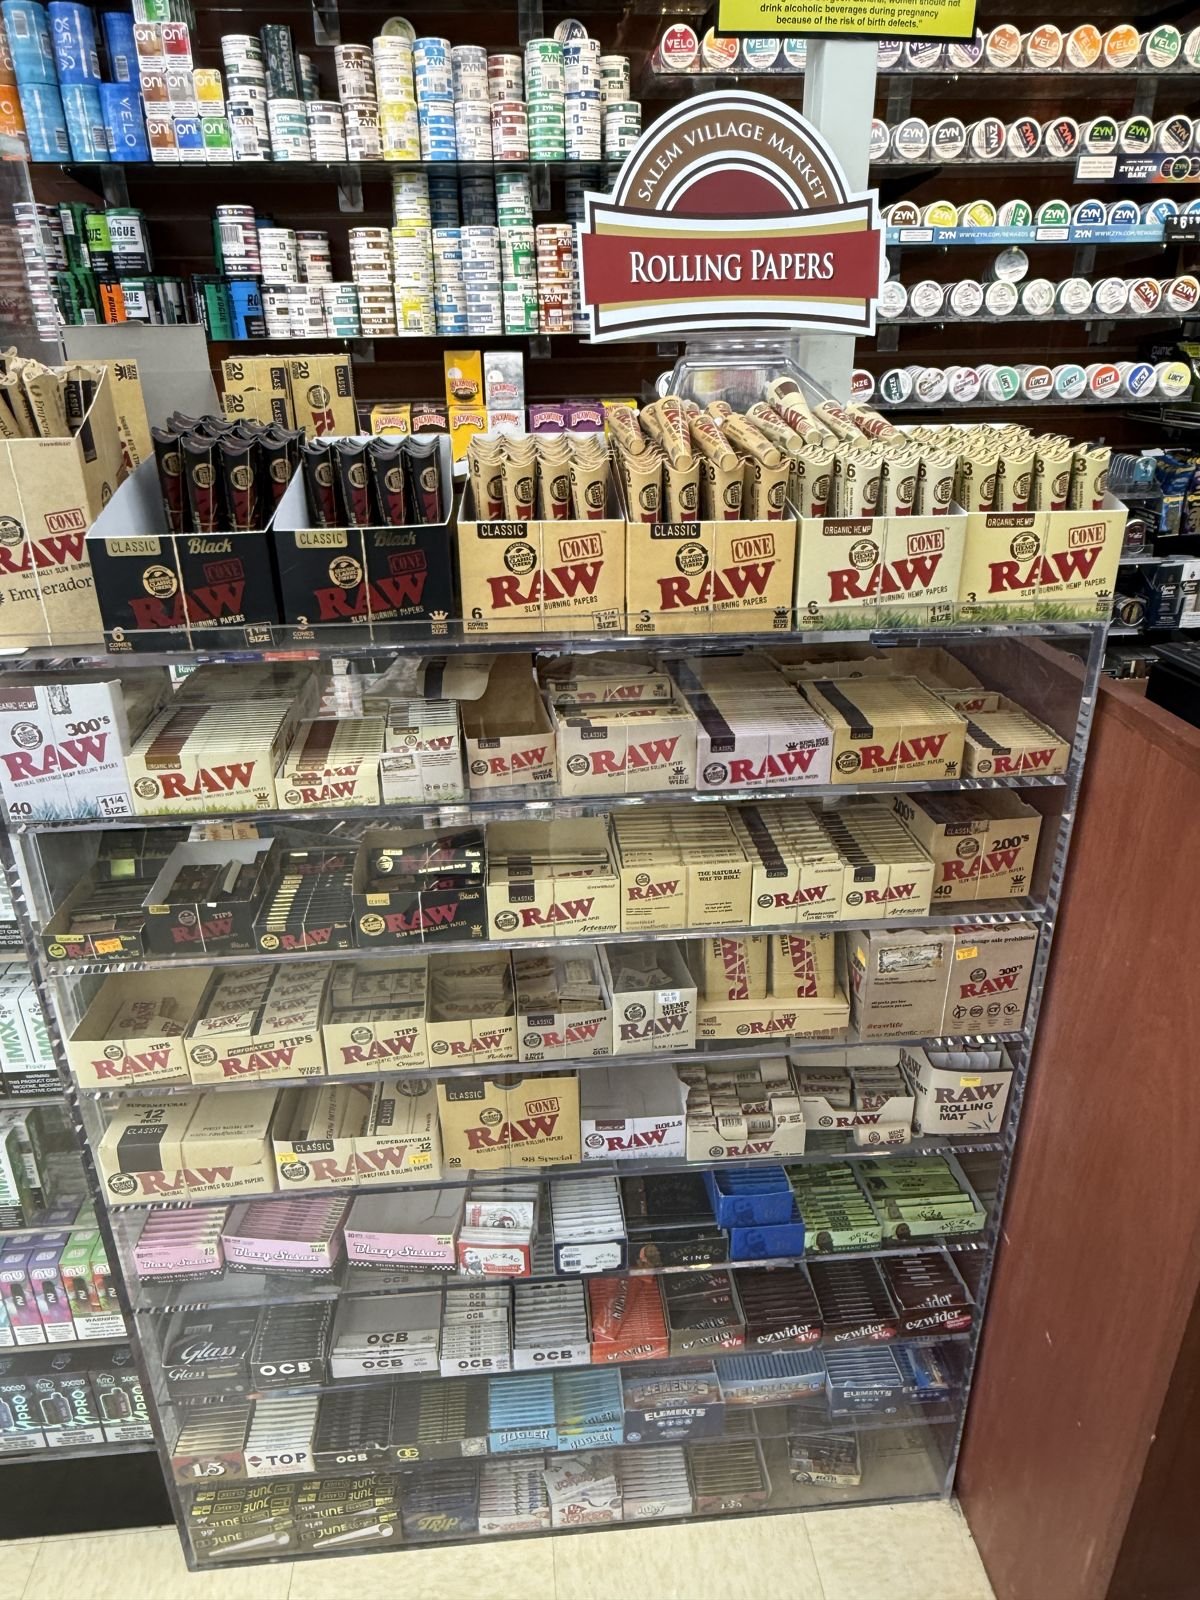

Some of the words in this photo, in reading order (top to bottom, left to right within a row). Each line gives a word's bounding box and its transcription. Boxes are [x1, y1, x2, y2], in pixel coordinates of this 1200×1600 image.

[760, 4, 782, 12] drink
[784, 4, 823, 13] alcoholic
[825, 6, 867, 16] beverages
[870, 8, 895, 18] during
[897, 9, 939, 19] pregnancy
[776, 16, 812, 25] because
[814, 16, 822, 25] of
[825, 17, 838, 25] the
[840, 17, 855, 26] risk
[857, 18, 865, 26] of
[868, 18, 886, 27] birth
[994, 35, 1018, 51] VELO
[1034, 37, 1059, 51] VELO
[1154, 35, 1177, 51] VELO
[344, 60, 363, 69] ZYN
[120, 98, 136, 147] VELO
[903, 127, 923, 138] ZYN
[939, 126, 959, 138] ZYN
[1093, 126, 1113, 136] ZYN
[1128, 125, 1149, 137] ZYN
[638, 143, 684, 202] SALEM
[684, 122, 764, 147] VILLAGE
[768, 133, 827, 200] MARKET
[895, 210, 914, 220] ZYN
[1045, 209, 1065, 219] ZYN
[630, 251, 742, 283] ROLLING
[750, 250, 834, 281] PAPERS
[233, 363, 244, 380] 20
[298, 362, 310, 379] 20
[1030, 378, 1046, 386] LUCY
[1063, 376, 1078, 388] LUCY
[1098, 376, 1113, 385] LUCY
[1168, 373, 1183, 382] LUCY
[69, 384, 80, 417] CLASSIC
[233, 395, 244, 412] 20
[375, 417, 406, 432] BACKWOODS
[413, 416, 446, 431] BACKWOODS
[452, 413, 483, 429] BACKWOODS
[491, 412, 519, 425] BACKWOODS
[534, 413, 564, 428] BACKWOODS
[50, 511, 82, 532] CONE
[987, 519, 1015, 527] ORGANIC
[1017, 518, 1034, 526] HEMP
[481, 524, 524, 536] CLASSIC
[654, 525, 698, 536] CLASSIC
[824, 526, 851, 534] ORGANIC
[854, 525, 872, 533] HEMP
[300, 533, 343, 545] CLASSIC
[374, 532, 416, 546] Black
[910, 533, 941, 552] CONE
[1072, 528, 1102, 545] CONE
[111, 540, 156, 553] CLASSIC
[188, 537, 232, 553] Black
[562, 537, 599, 559] CONE
[735, 538, 771, 559] CONE
[988, 547, 1102, 593] RAW
[828, 553, 943, 602] RAW
[11, 576, 93, 602] Emperador
[487, 562, 604, 609] RAW
[656, 562, 776, 611] RAW
[1021, 588, 1035, 596] SLOW
[1039, 585, 1063, 594] BURNING
[1065, 582, 1081, 591] HEMP
[1084, 578, 1106, 588] PAPERS
[524, 604, 540, 612] SLOW
[544, 600, 571, 610] BURNING
[574, 596, 598, 605] PAPERS
[693, 606, 709, 614] SLOW
[712, 600, 740, 612] BURNING
[743, 596, 767, 607] PAPERS
[807, 601, 819, 614] 6
[471, 607, 482, 619] 6
[640, 610, 650, 622] 3
[930, 614, 951, 622] SIZE
[296, 616, 308, 629] 3
[597, 620, 618, 629] SIZE
[248, 634, 270, 643] SIZE
[65, 716, 110, 736] 300's
[582, 731, 608, 739] CLASSIC
[1, 732, 108, 782] RAW
[589, 736, 682, 776] RAW
[859, 732, 950, 769] RAW
[728, 749, 819, 784] RAW
[157, 762, 255, 799] RAW
[10, 802, 32, 815] 40
[104, 805, 128, 815] SIZE
[992, 834, 1029, 852] 200's
[934, 885, 952, 896] 40
[212, 911, 232, 919] TIPS
[384, 903, 458, 933] RAW
[518, 898, 595, 927] RAW
[1005, 935, 1035, 943] prohibited
[960, 974, 1019, 999] RAW
[662, 1001, 690, 1011] HEMP
[394, 1027, 418, 1036] TIPS
[149, 1042, 170, 1050] TIPS
[341, 1035, 417, 1065] RAW
[92, 1051, 172, 1080] RAW
[219, 1047, 297, 1078] RAW
[450, 1090, 482, 1100] CLASSIC
[935, 1084, 1004, 1104] RAW
[528, 1100, 557, 1114] CONE
[940, 1102, 993, 1113] ROLLING
[939, 1112, 967, 1121] MAT
[127, 1127, 164, 1135] CLASSIC
[655, 1120, 683, 1129] ROLLS
[296, 1143, 331, 1152] CLASSIC
[234, 1248, 270, 1260] Blazy
[274, 1251, 318, 1261] Susan
[356, 1244, 393, 1256] Blazy
[398, 1248, 446, 1257] Susan
[484, 1251, 521, 1262] ZIG-ZAG
[367, 1333, 408, 1343] OCB
[181, 1341, 236, 1363] Glass
[533, 1351, 572, 1361] OCB
[260, 1362, 311, 1375] OCB
[362, 1359, 403, 1368] OCB
[458, 1359, 493, 1368] OCB
[169, 1367, 205, 1380] Glass
[844, 1390, 892, 1398] ELEMENTS
[644, 1409, 706, 1421] ELEMENTS
[500, 1430, 549, 1444] BUGLER
[570, 1432, 614, 1449] BUGLER
[266, 1453, 306, 1466] TOP
[336, 1454, 367, 1463] OCB
[317, 1524, 347, 1538] JUNE
[212, 1534, 241, 1546] JUNE
